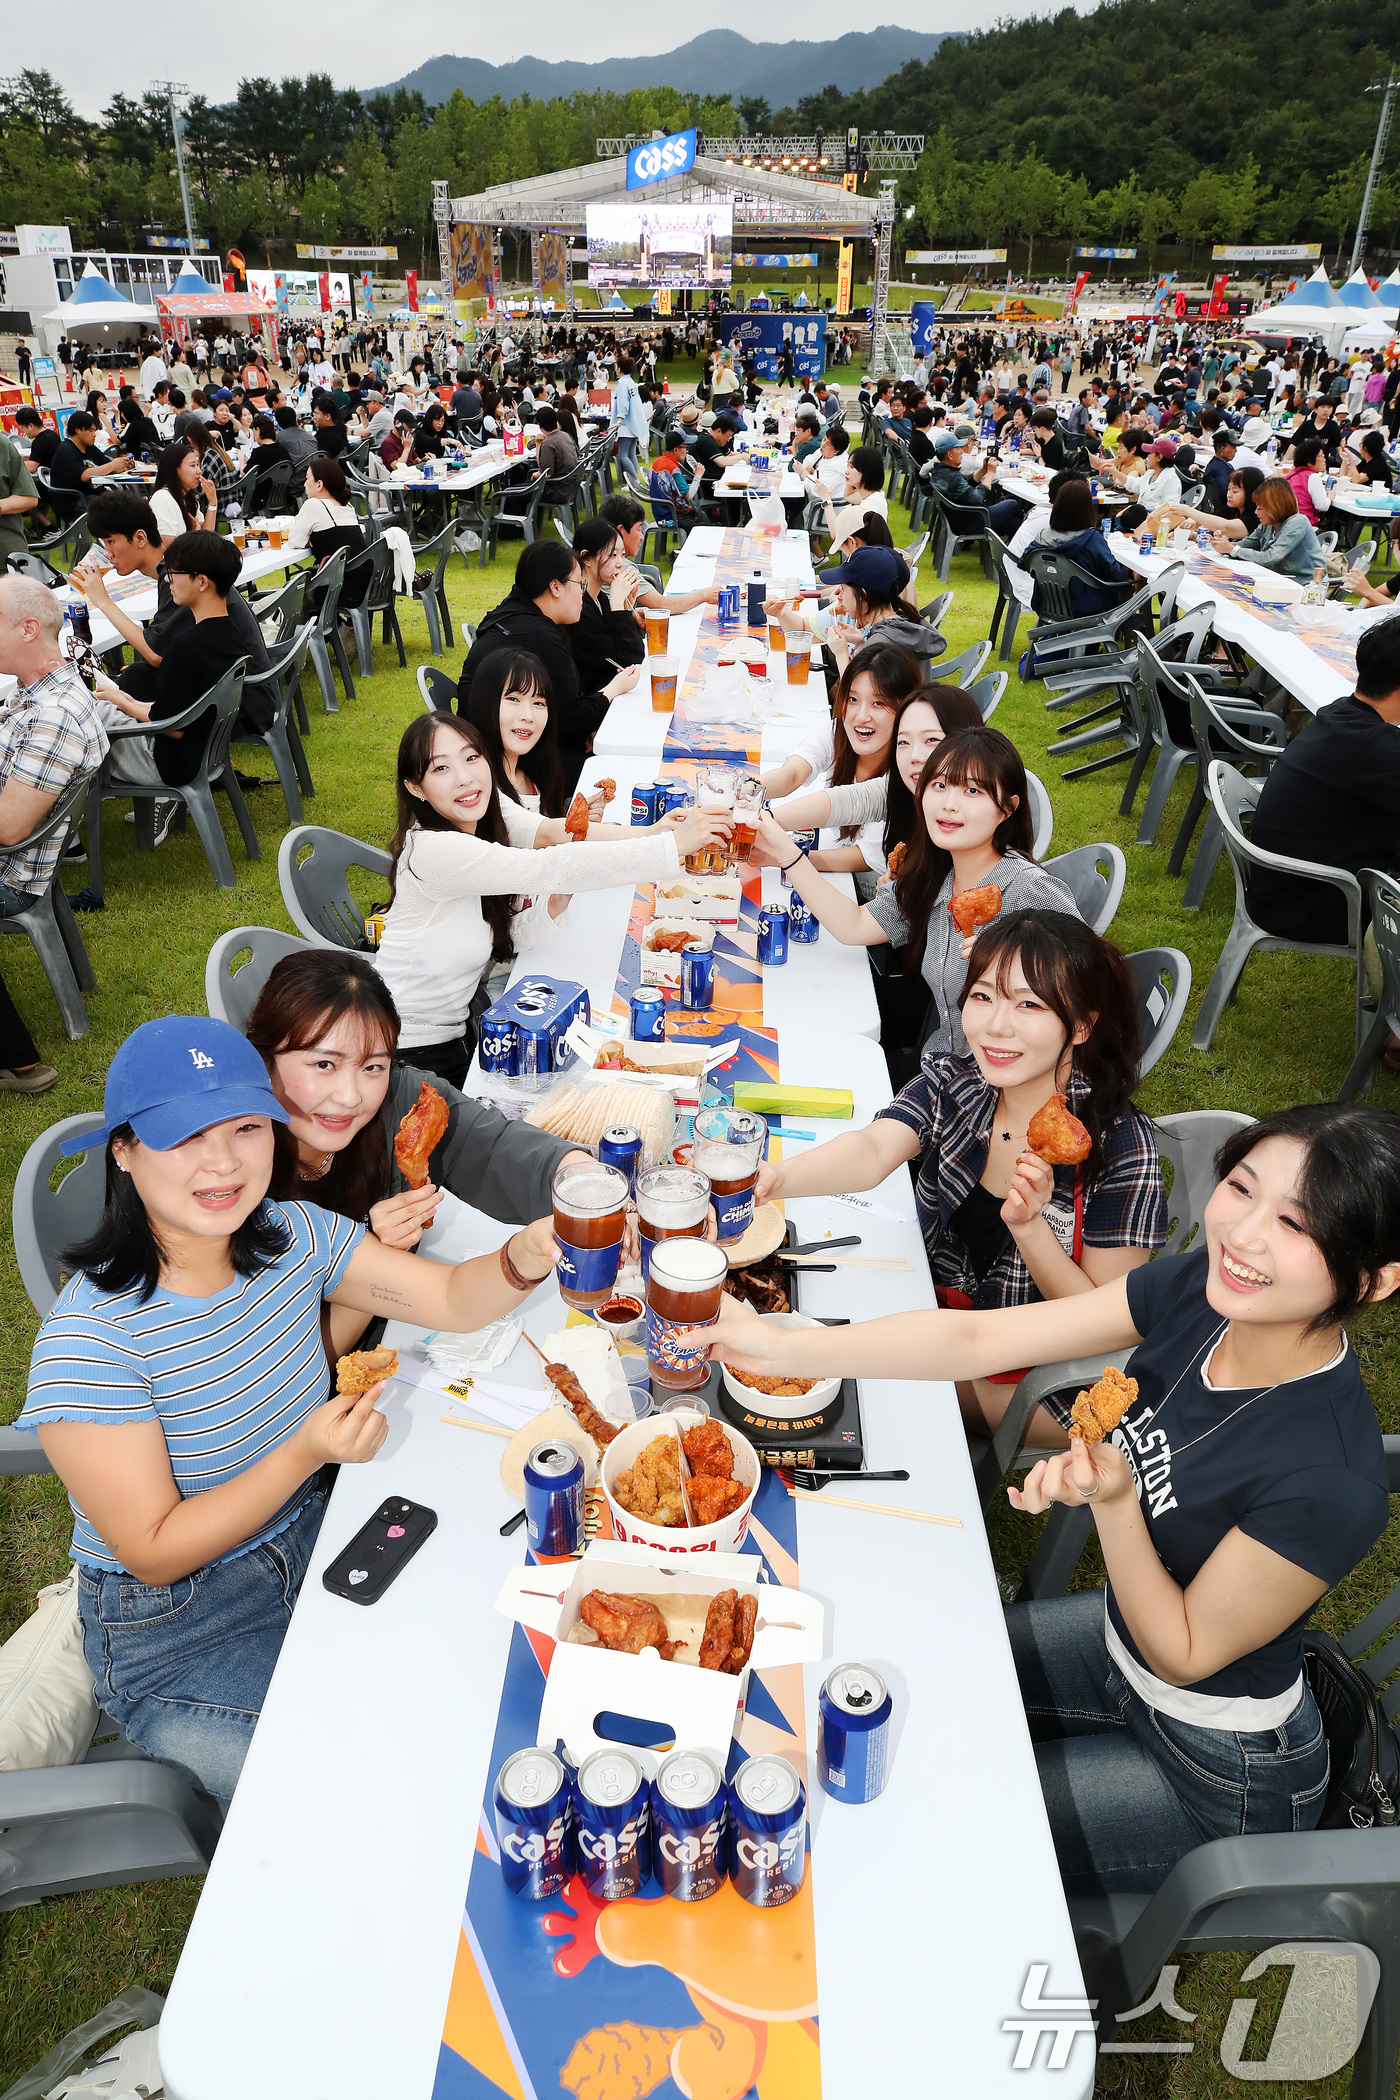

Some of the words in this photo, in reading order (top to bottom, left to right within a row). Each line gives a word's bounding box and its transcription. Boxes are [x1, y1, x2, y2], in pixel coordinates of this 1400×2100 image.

[634, 137, 688, 180] Cass
[631, 806, 648, 814] EPSI
[790, 903, 812, 921] Cas
[188, 1048, 215, 1069] LA
[528, 1843, 564, 1872] FRESH
[599, 1847, 637, 1870] FRESH
[682, 1847, 718, 1874] FRESH
[759, 1853, 796, 1879] FRESH
